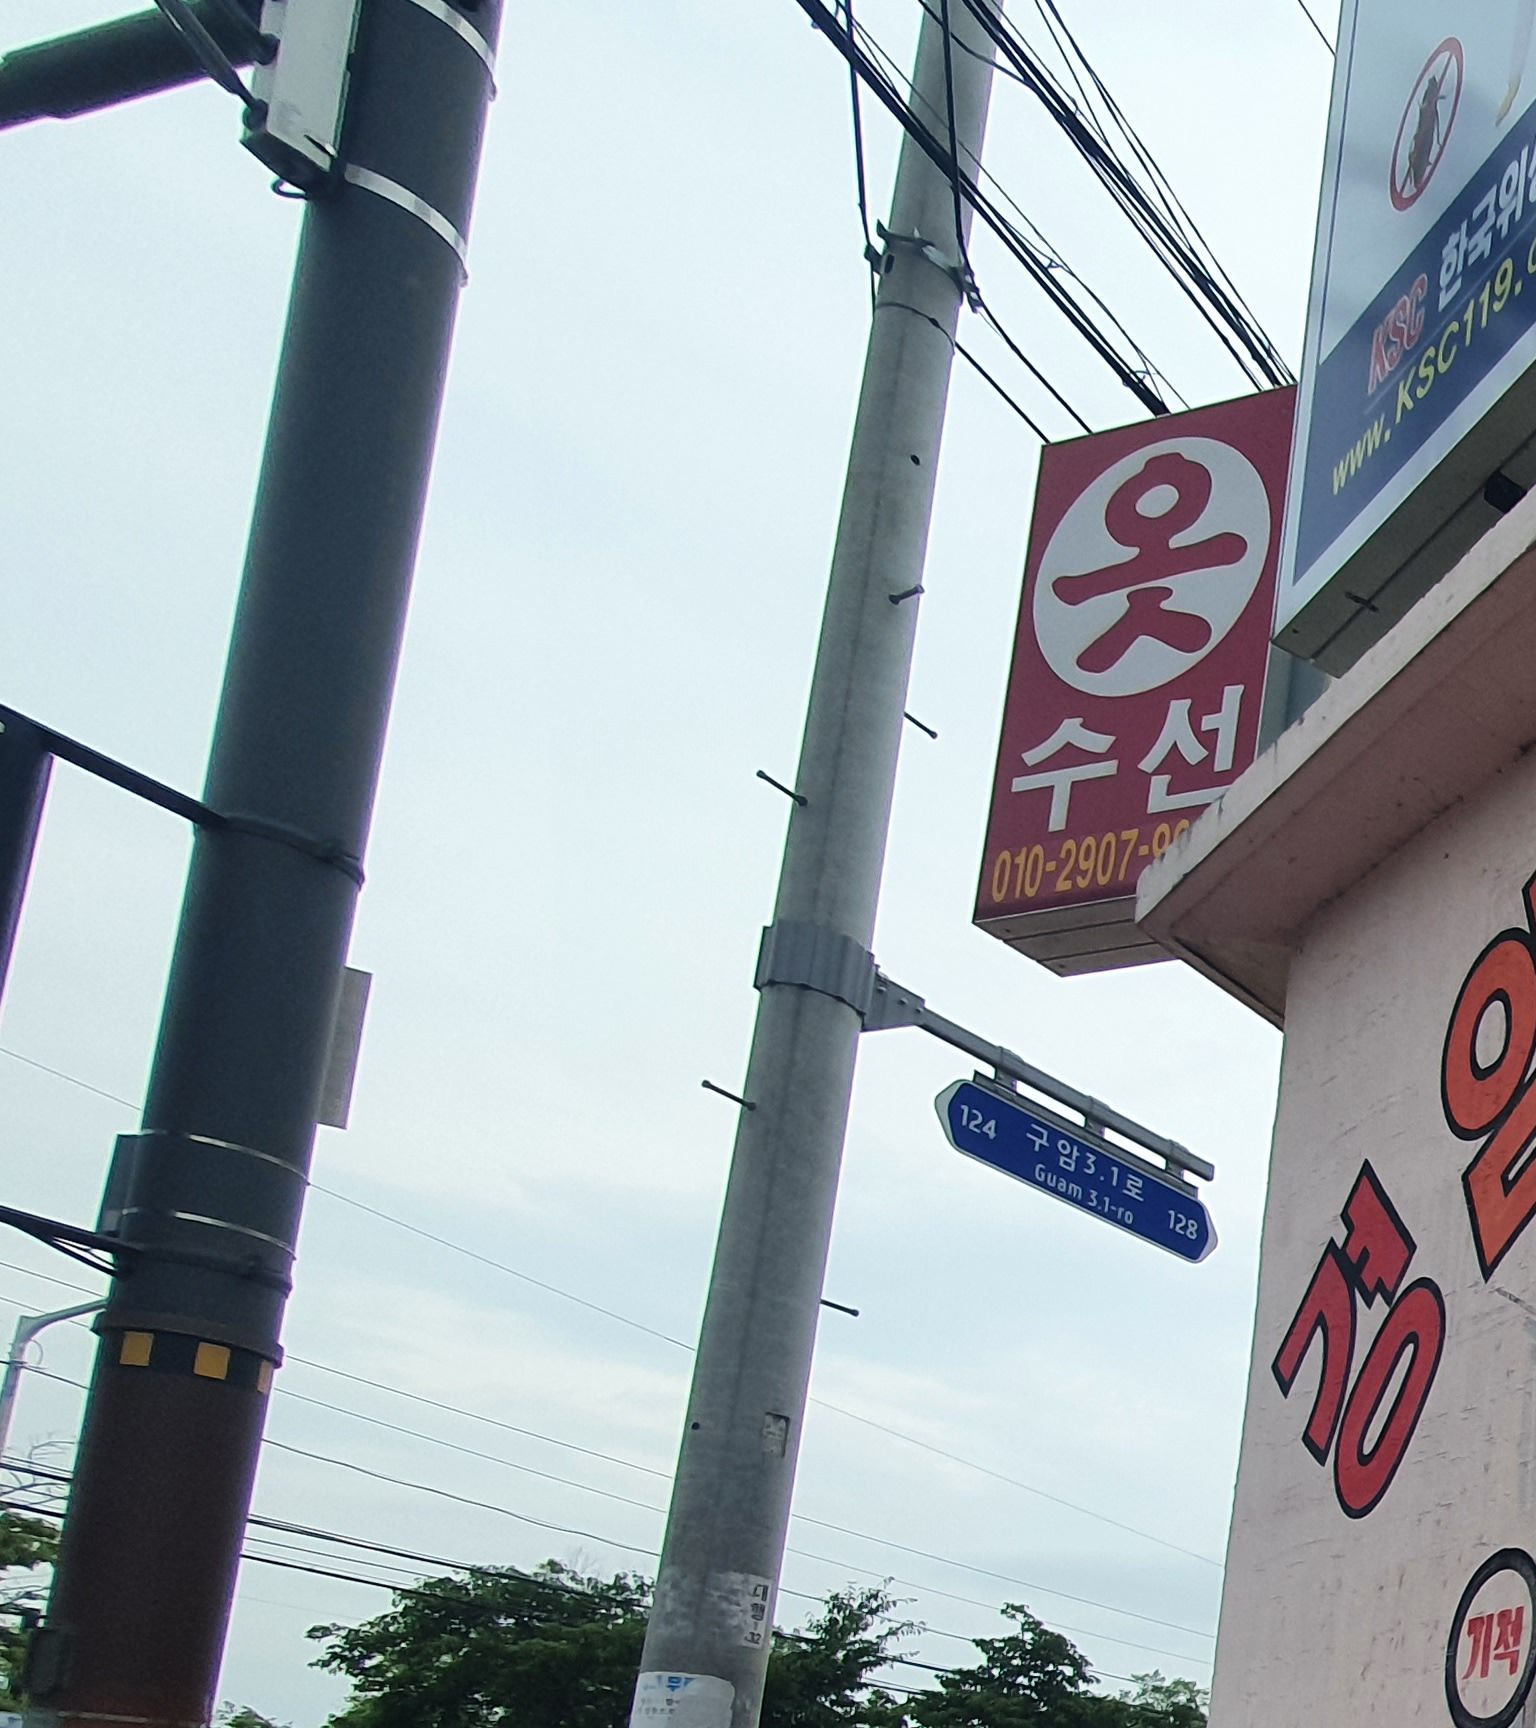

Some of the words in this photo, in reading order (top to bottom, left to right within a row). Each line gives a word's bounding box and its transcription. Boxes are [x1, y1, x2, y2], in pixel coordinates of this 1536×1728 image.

[1368, 273, 1428, 395] KSC
[1052, 452, 1249, 675] 옷
[1011, 684, 1246, 833] 수선
[959, 1105, 997, 1140] 124
[1034, 1163, 1083, 1201] Guam
[1087, 1190, 1134, 1226] 3.1-ro
[1167, 1210, 1199, 1241] 128
[1461, 1606, 1525, 1680] 기적
